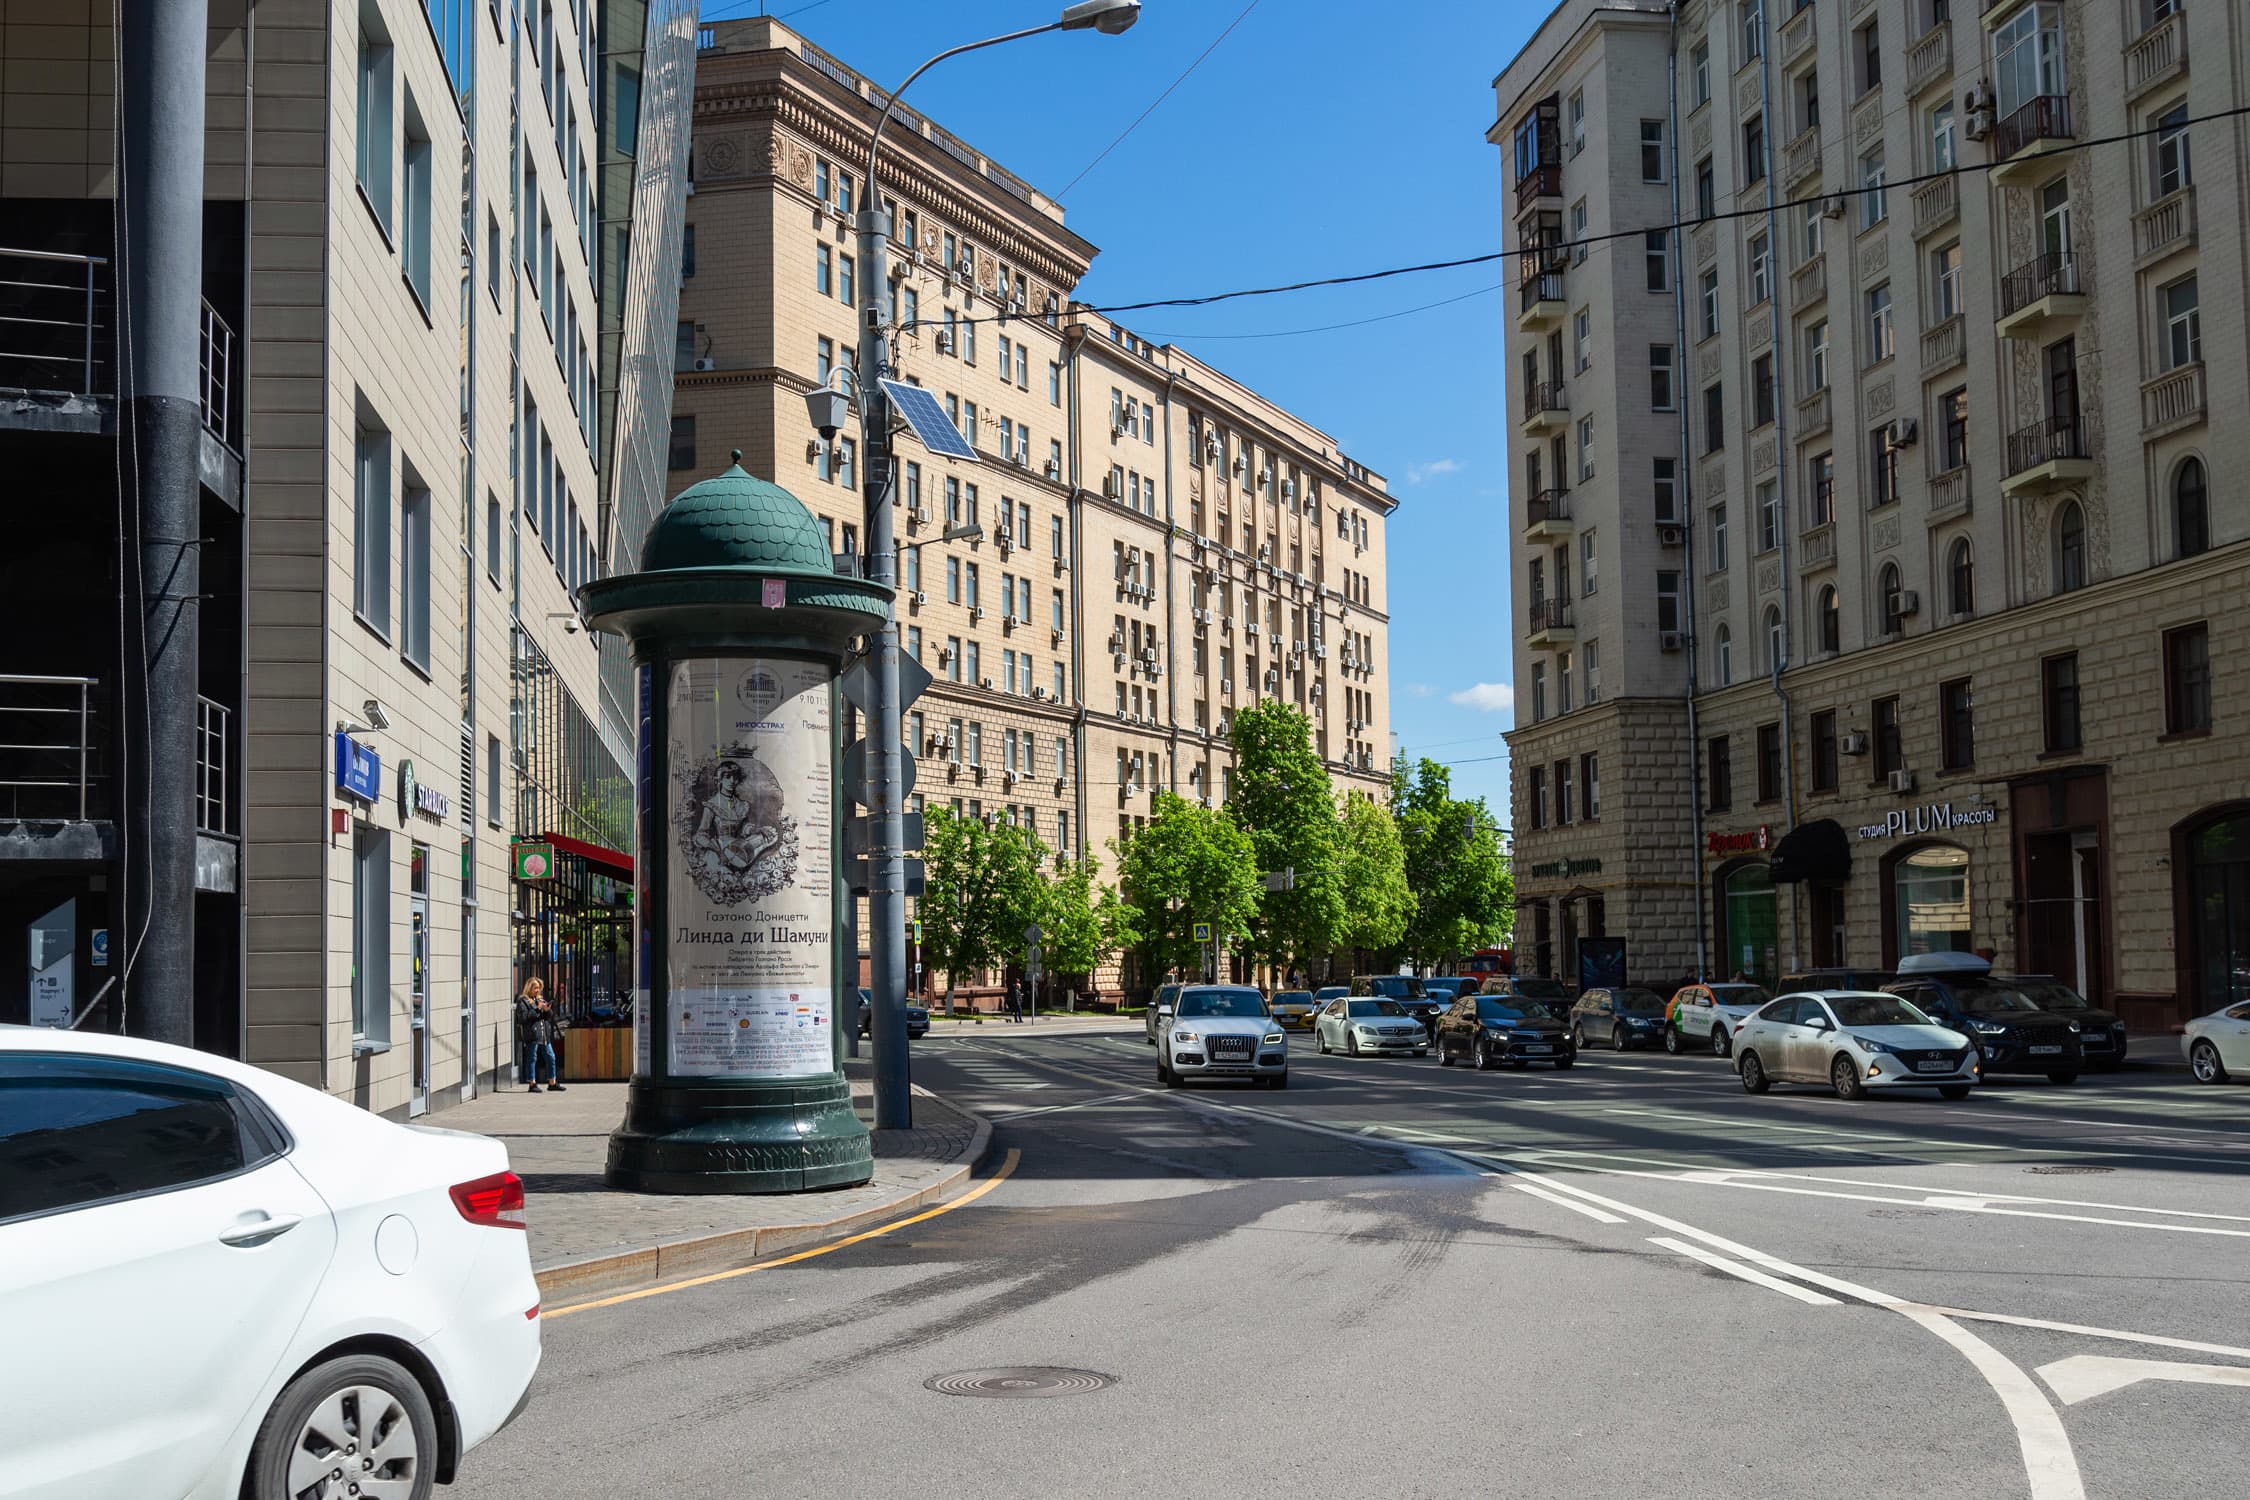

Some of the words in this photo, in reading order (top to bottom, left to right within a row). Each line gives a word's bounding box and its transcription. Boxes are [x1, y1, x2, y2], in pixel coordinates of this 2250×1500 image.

[736, 721, 785, 729] ИНГОССТРАХ
[1858, 822, 1886, 839] СТУДИЯ
[1886, 803, 1952, 837] PLUM
[1952, 809, 1995, 827] КРАСОТЫ
[706, 911, 753, 922] Гаэтано
[755, 911, 808, 923] Доницетти
[676, 927, 734, 945] Линда
[740, 930, 764, 945] ди
[771, 927, 829, 947] Шамуни
